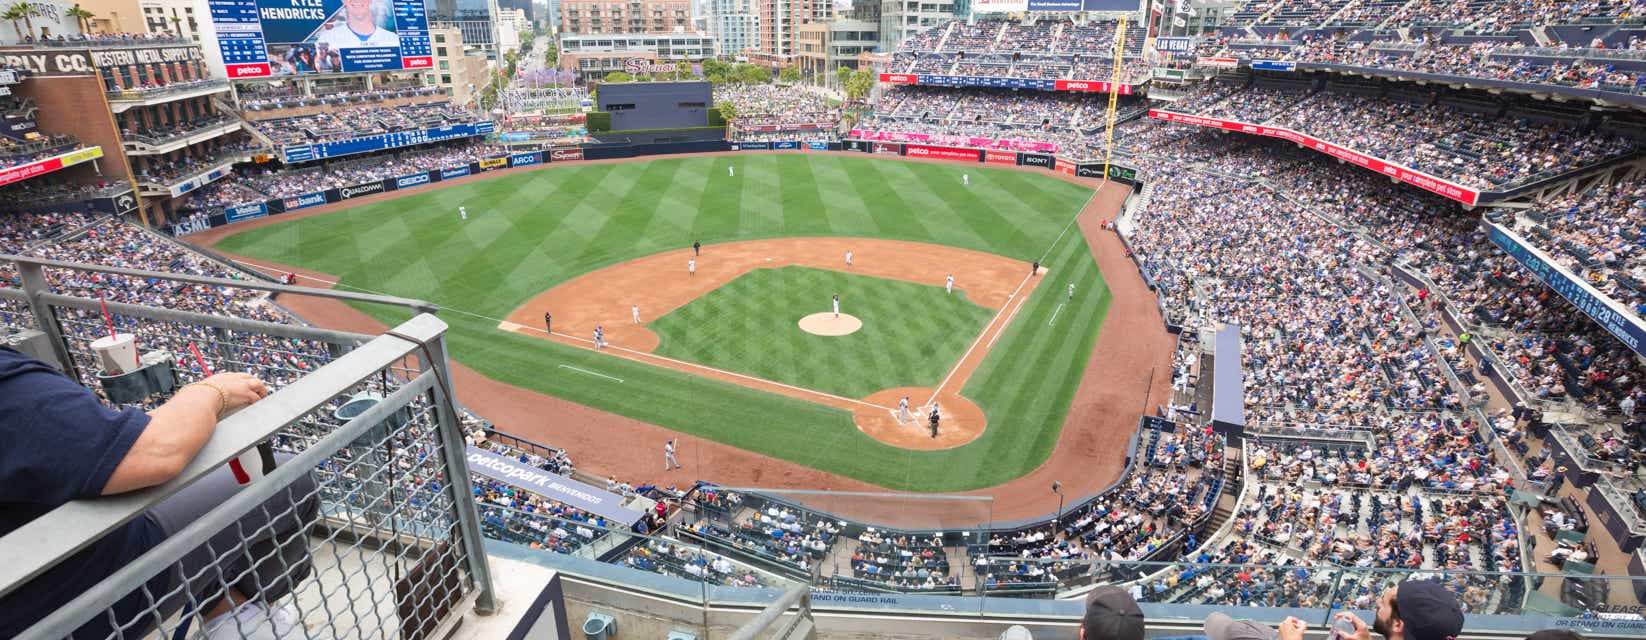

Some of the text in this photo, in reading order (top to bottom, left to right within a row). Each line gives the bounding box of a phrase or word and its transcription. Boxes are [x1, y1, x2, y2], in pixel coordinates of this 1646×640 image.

[260, 7, 325, 20] HENDRICKS
[1169, 39, 1188, 51] VEGAS
[55, 54, 95, 73] CO.
[94, 50, 136, 67] WESTERN
[135, 49, 164, 64] METAL
[162, 47, 188, 62] SUPPLY
[237, 66, 262, 76] petco
[1066, 82, 1088, 90] petco
[908, 147, 929, 156] petco
[513, 155, 534, 165] ARCO
[399, 175, 429, 185] GEICO
[1412, 174, 1437, 190] complete
[1436, 182, 1446, 195] pet
[1447, 186, 1462, 198] store
[341, 183, 382, 198] QUALCOMM
[175, 217, 211, 235] ASML
[1598, 306, 1627, 327] 28 KYLE
[1607, 321, 1639, 348] HENDRICKS
[1569, 620, 1600, 628] STAND
